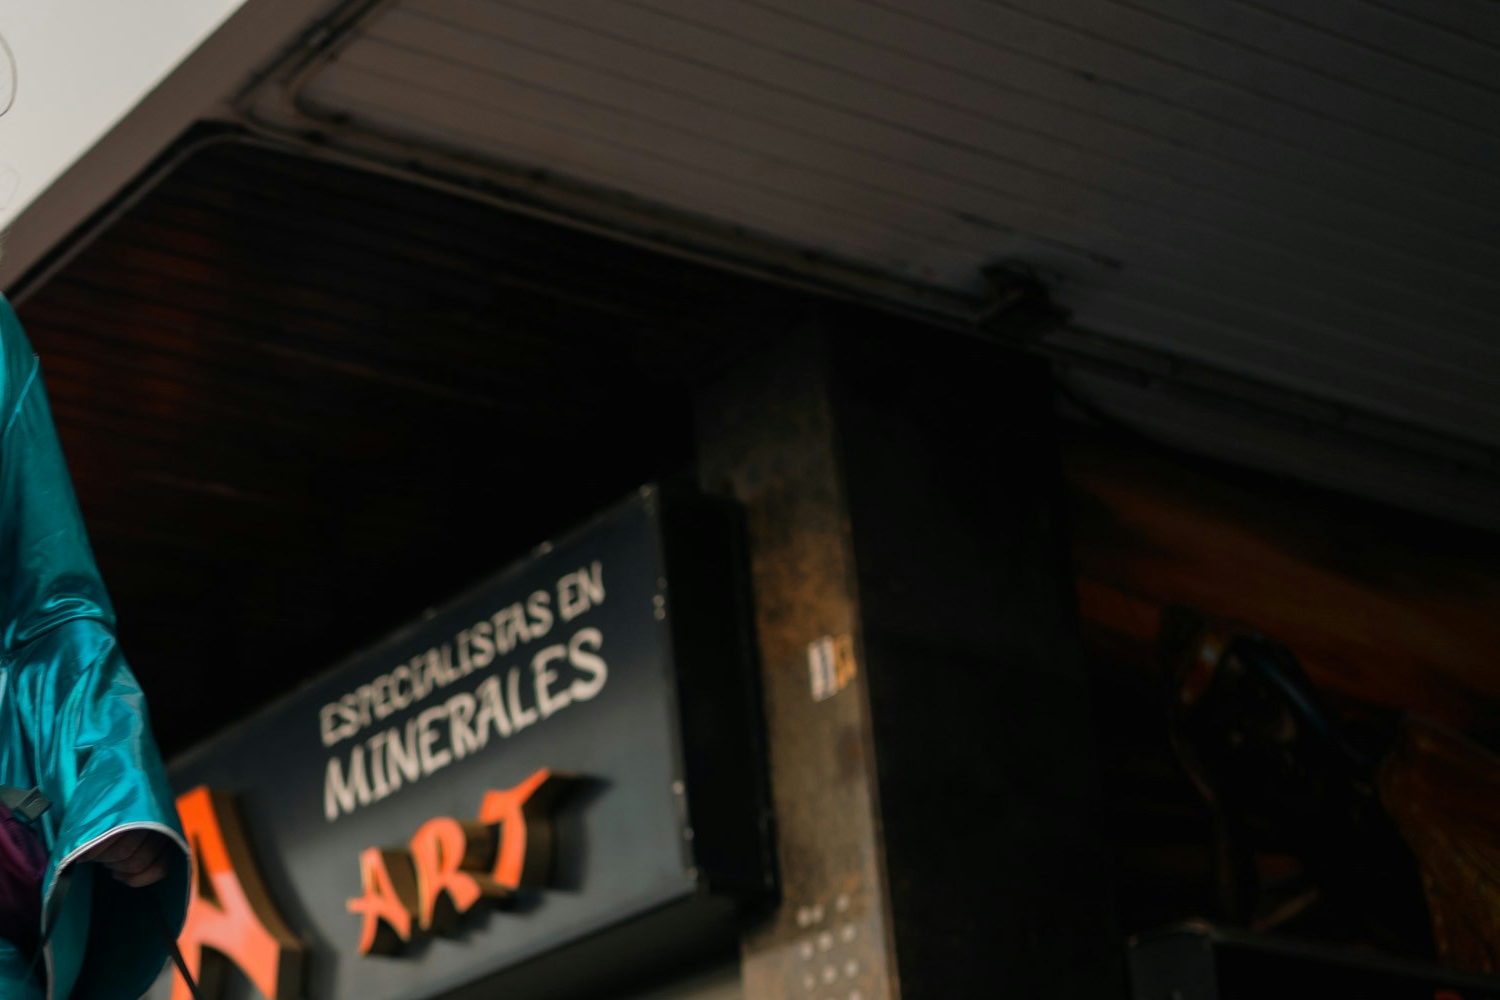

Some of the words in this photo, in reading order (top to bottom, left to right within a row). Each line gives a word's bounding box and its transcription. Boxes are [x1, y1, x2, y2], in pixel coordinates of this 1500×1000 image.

[319, 589, 554, 747] ESPECIALISTAS
[556, 560, 605, 622] EN
[324, 627, 608, 820] MINERALES
[346, 767, 550, 957] ART
